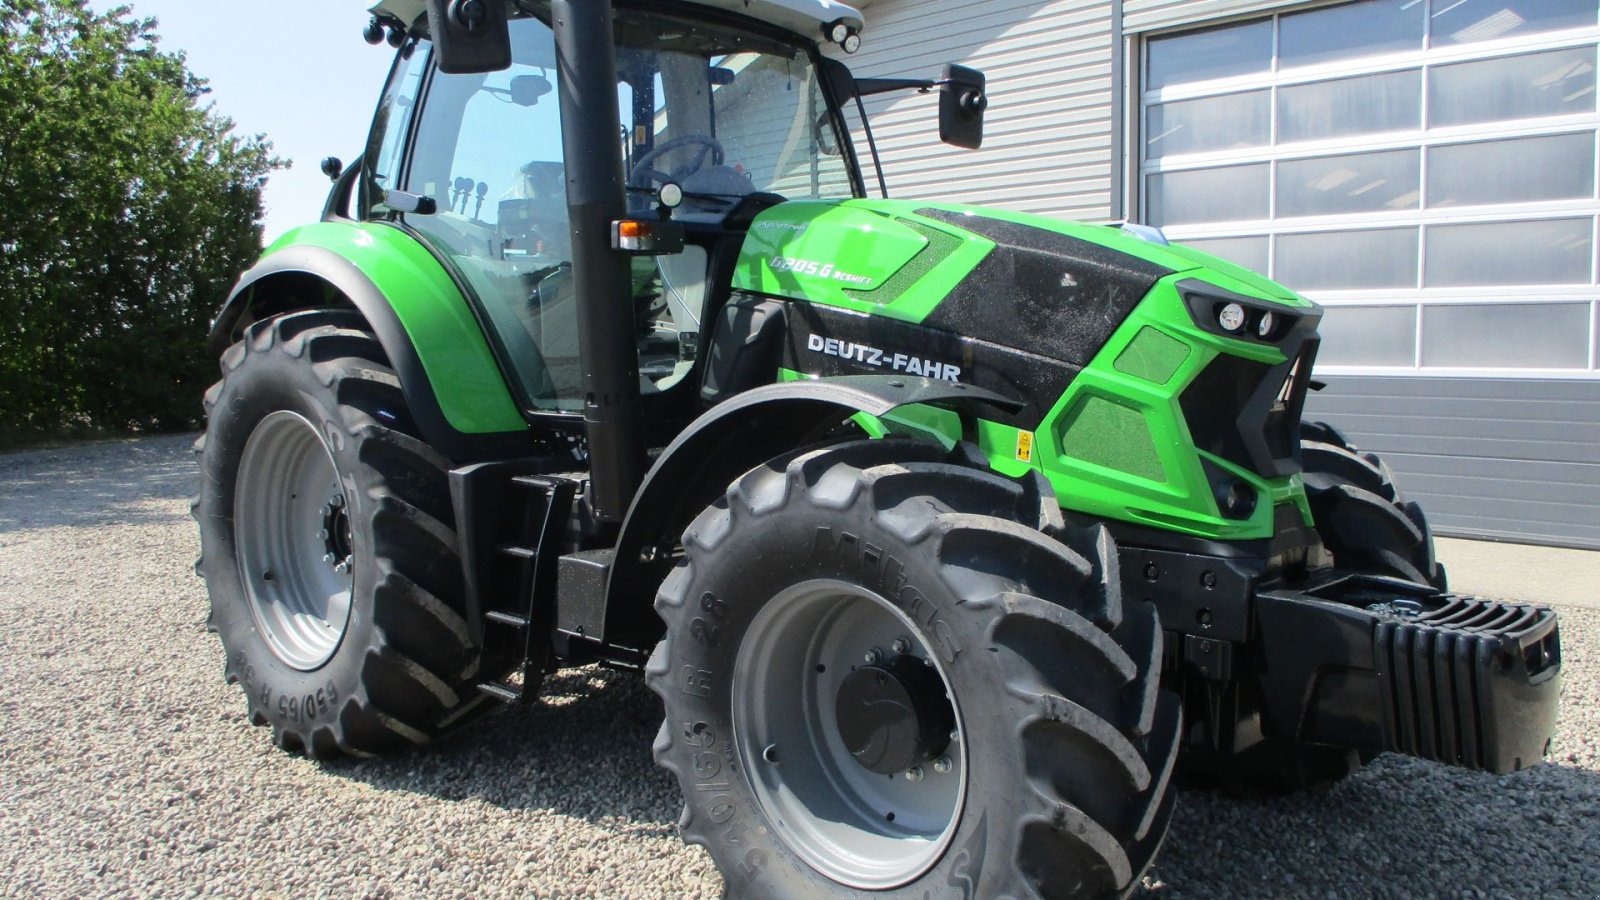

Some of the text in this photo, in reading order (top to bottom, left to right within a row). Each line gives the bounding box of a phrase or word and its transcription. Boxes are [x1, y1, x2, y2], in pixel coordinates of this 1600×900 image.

[769, 256, 820, 275] 6205
[820, 263, 834, 279] G
[807, 333, 962, 383] DEUTZ-FAHR
[808, 526, 964, 665] Mitas
